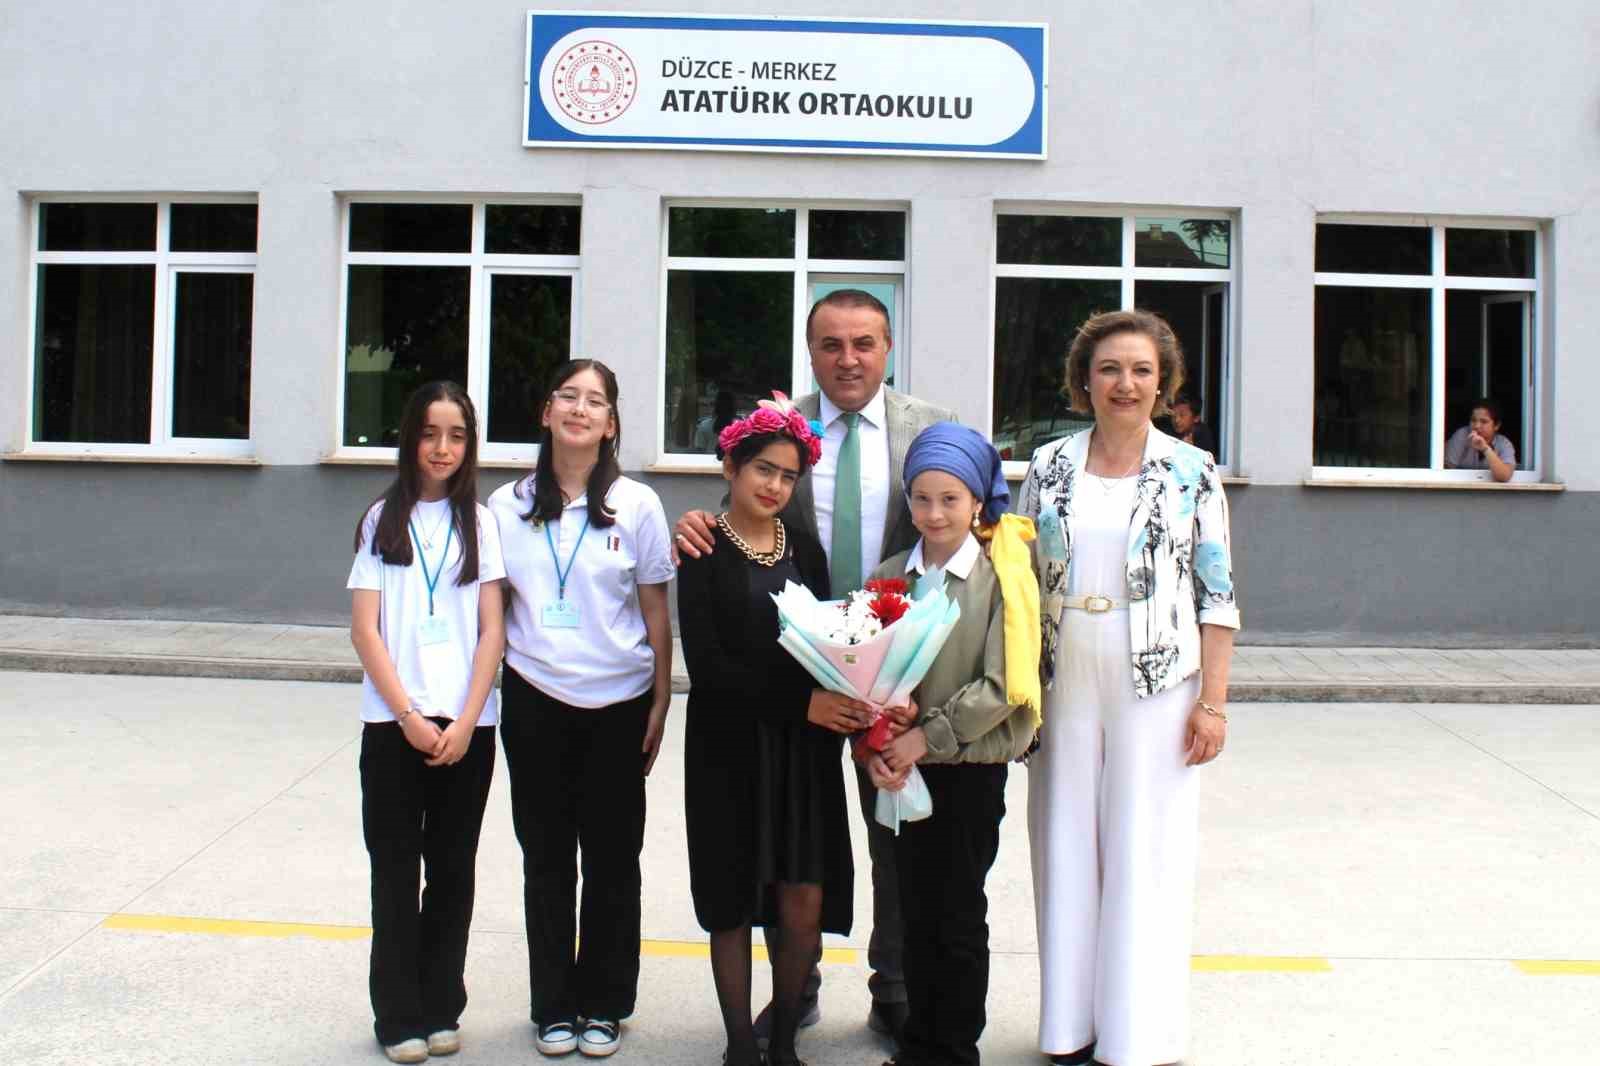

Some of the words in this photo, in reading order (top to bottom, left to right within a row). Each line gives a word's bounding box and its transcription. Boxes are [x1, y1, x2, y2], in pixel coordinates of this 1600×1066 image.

[662, 57, 732, 79] DÜZCE
[751, 61, 837, 81] MERKEZ
[660, 86, 791, 114] ATATÜRK
[798, 91, 973, 120] ORTAOKULU
